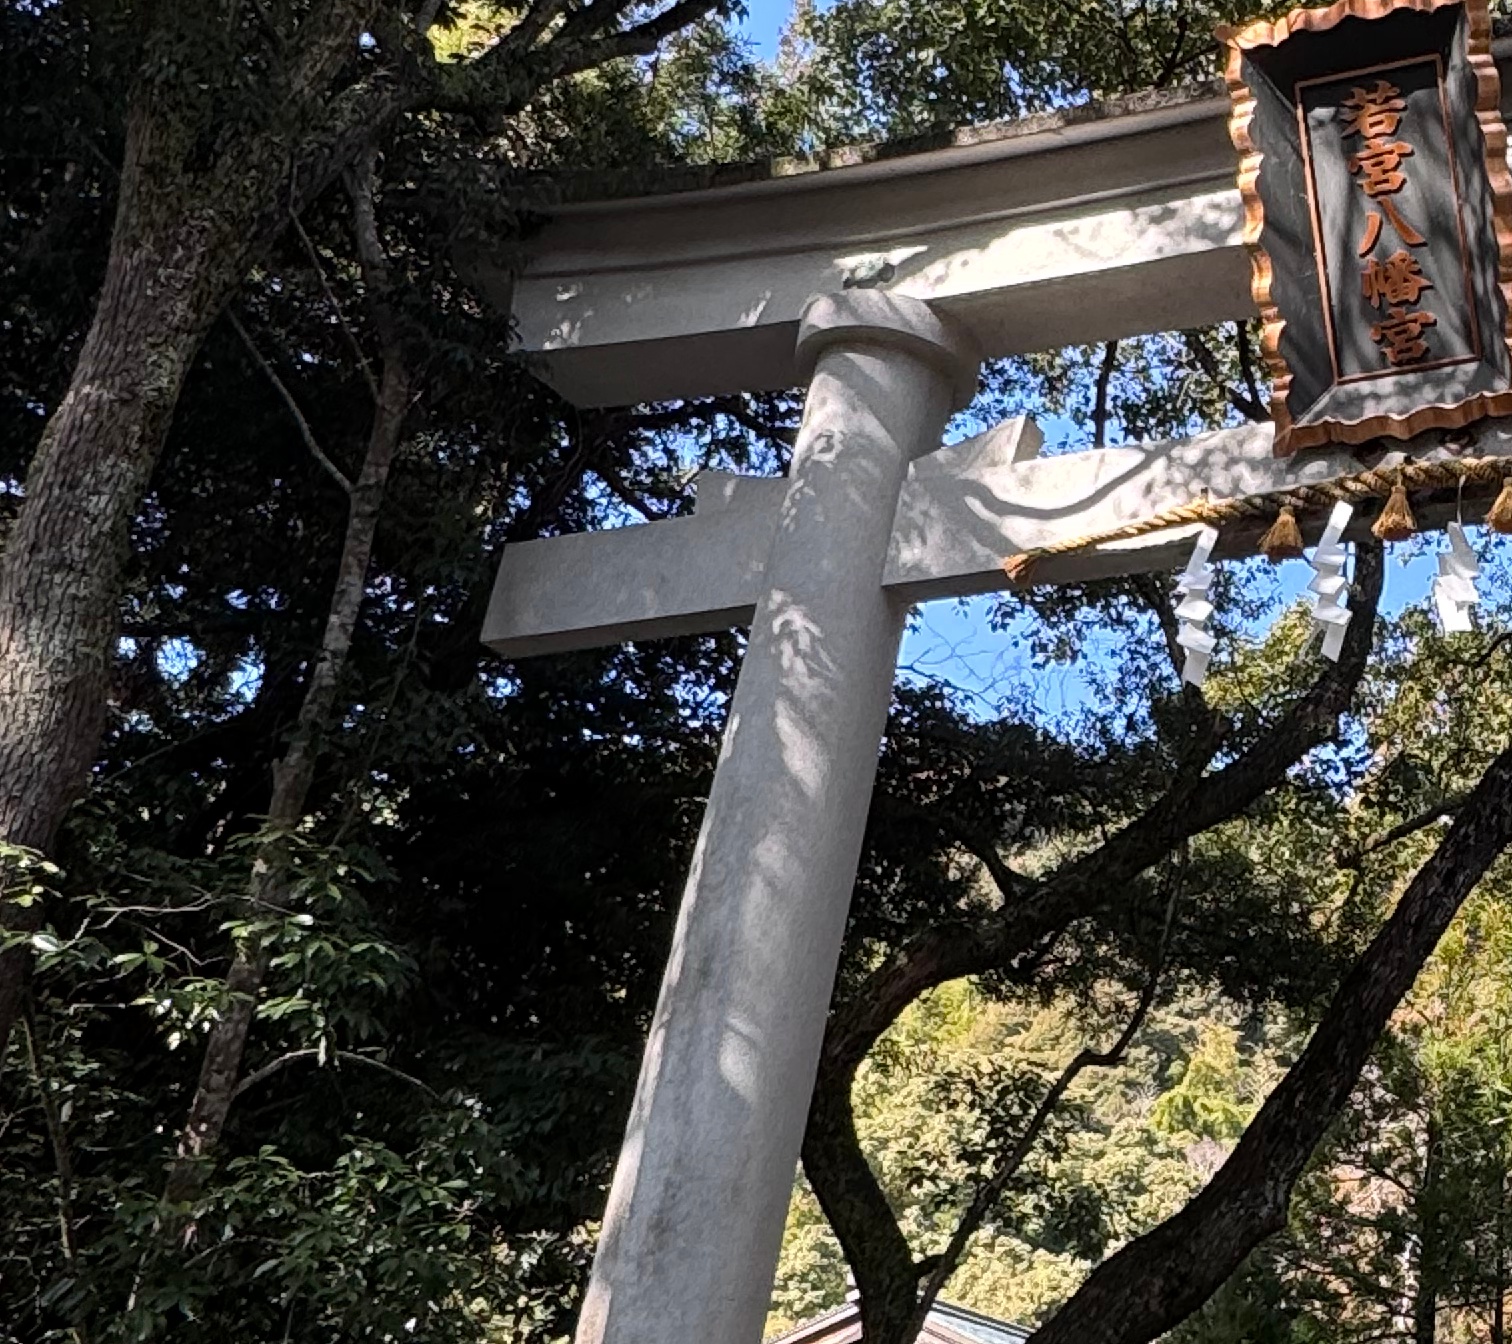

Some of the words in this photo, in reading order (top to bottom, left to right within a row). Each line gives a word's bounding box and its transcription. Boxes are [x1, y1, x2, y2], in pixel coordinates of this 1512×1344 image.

[1341, 80, 1437, 362] 若宮八幡宮
